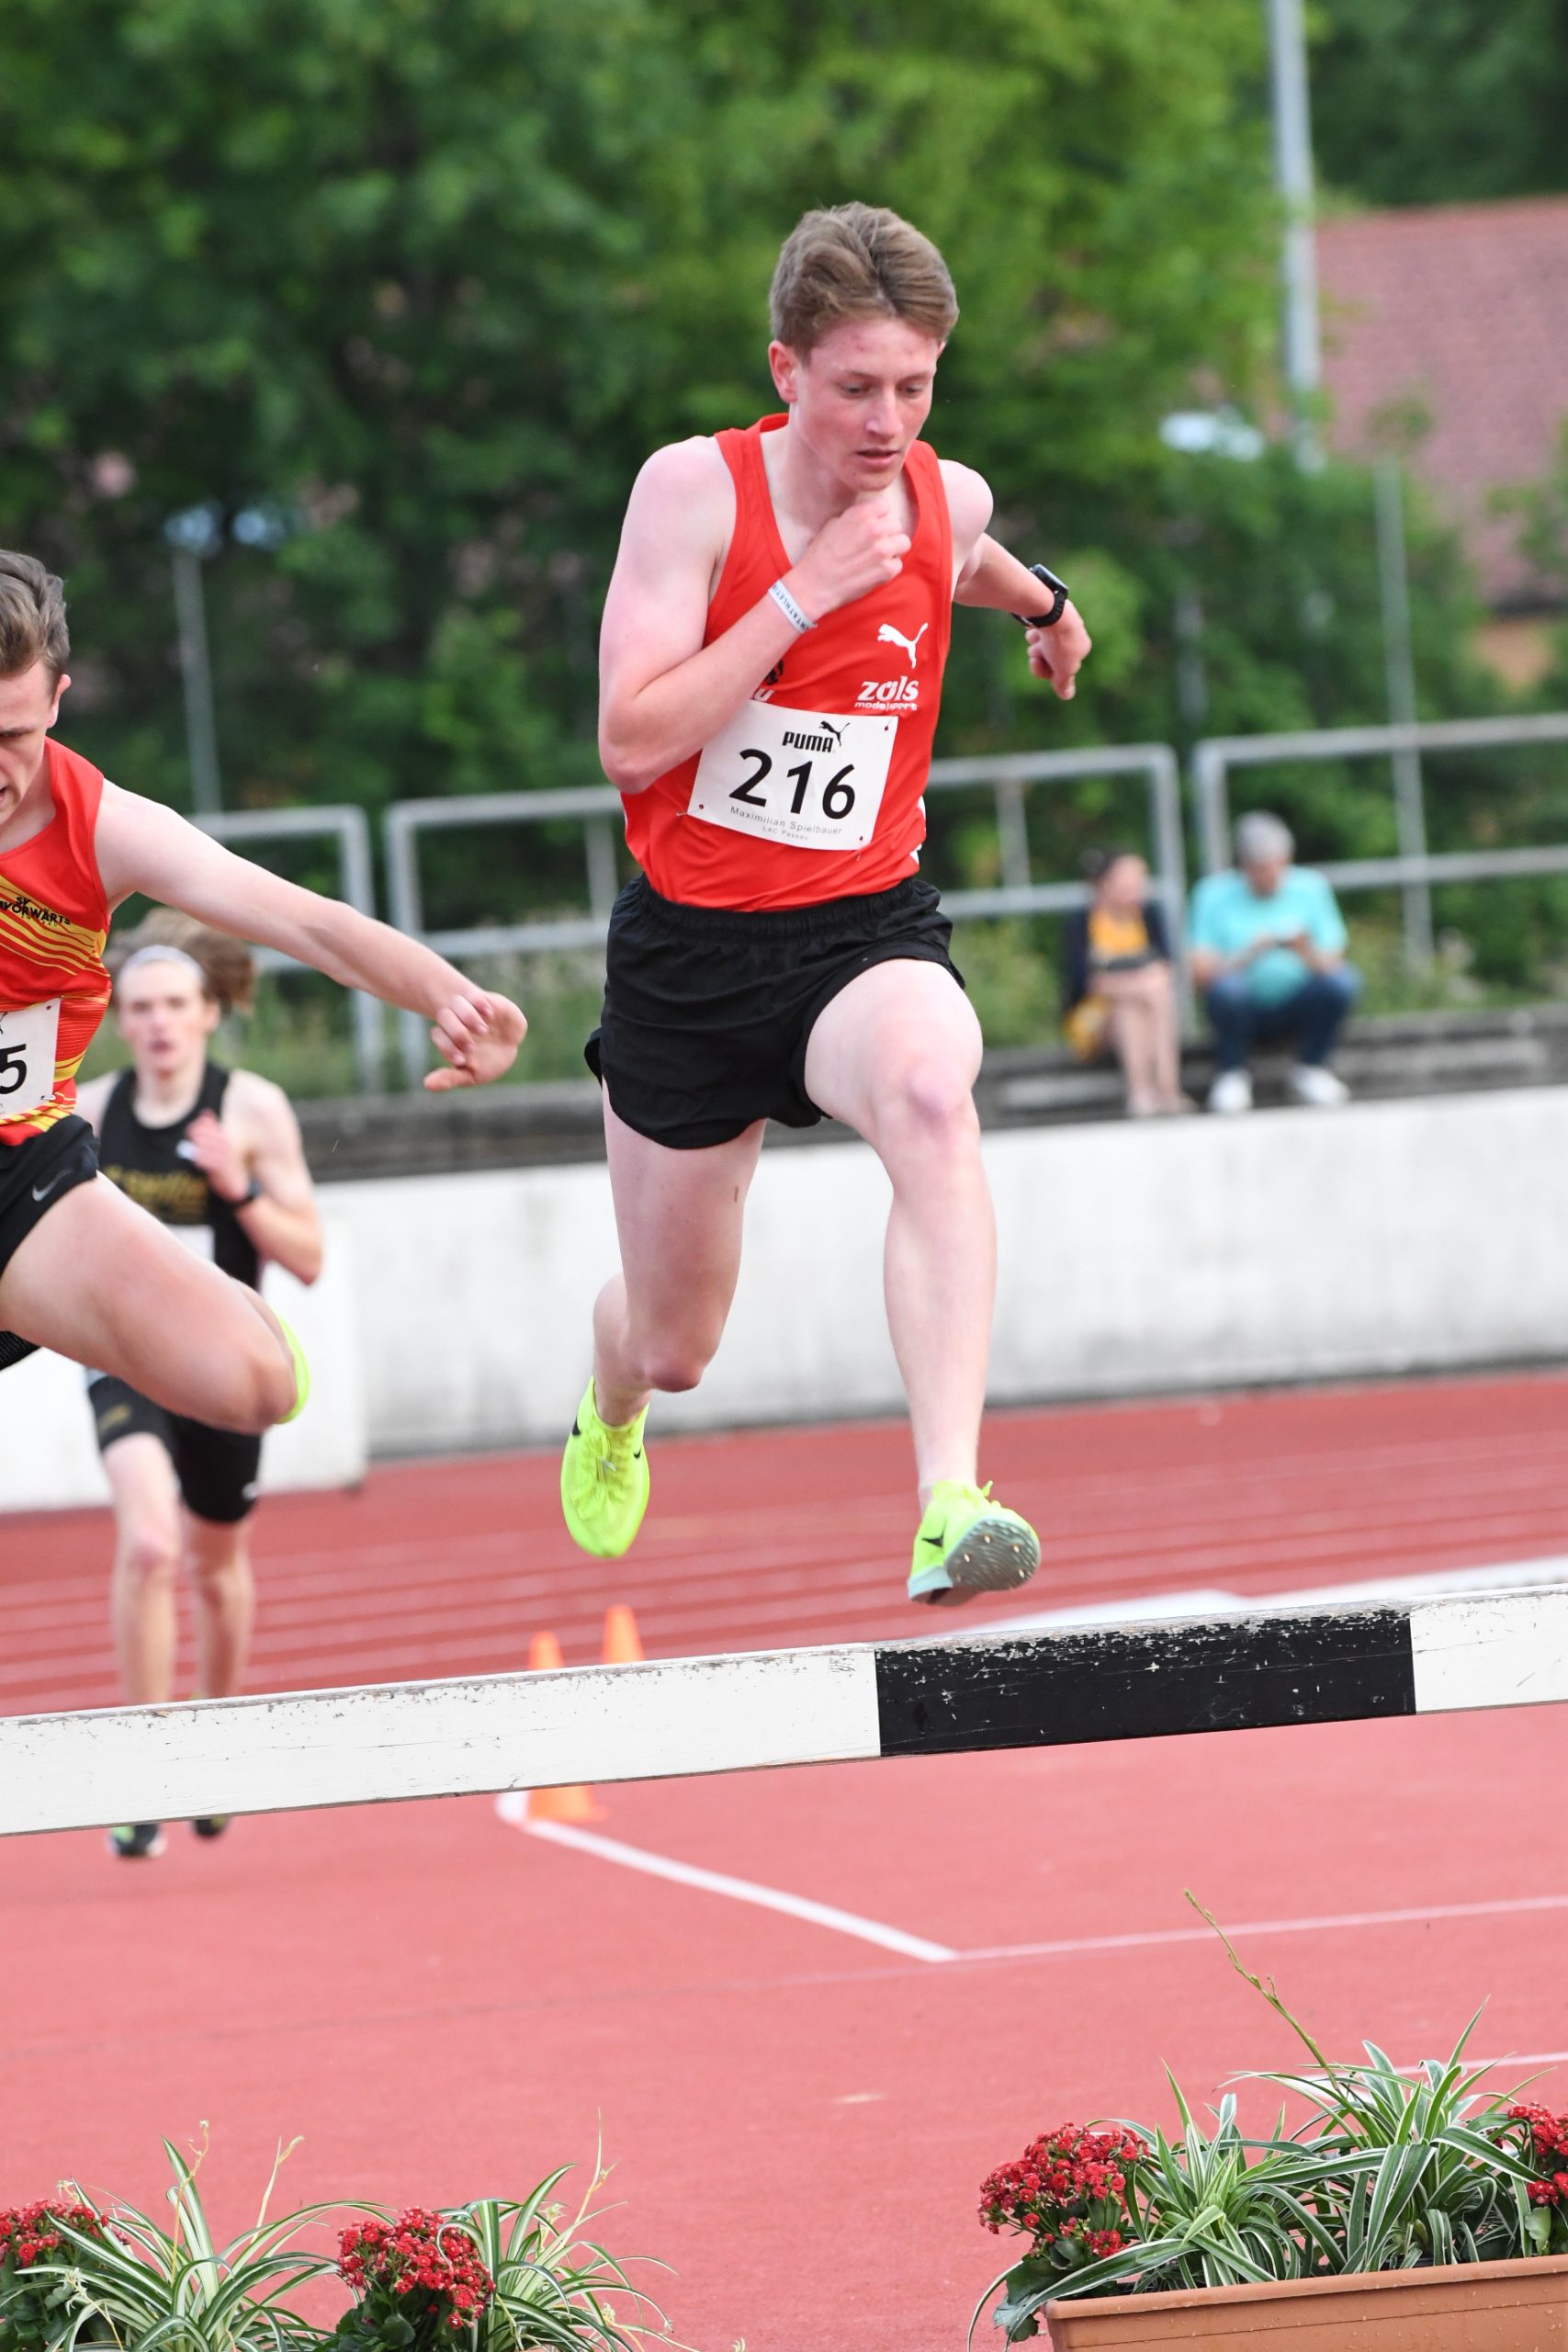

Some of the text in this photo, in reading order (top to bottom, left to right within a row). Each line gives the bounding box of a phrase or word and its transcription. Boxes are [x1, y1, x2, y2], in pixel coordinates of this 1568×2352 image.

[782, 731, 833, 753] PUMA
[728, 749, 855, 820] 216
[730, 806, 842, 835] Maximilian Spielbauer
[0, 1044, 27, 1094] 5
